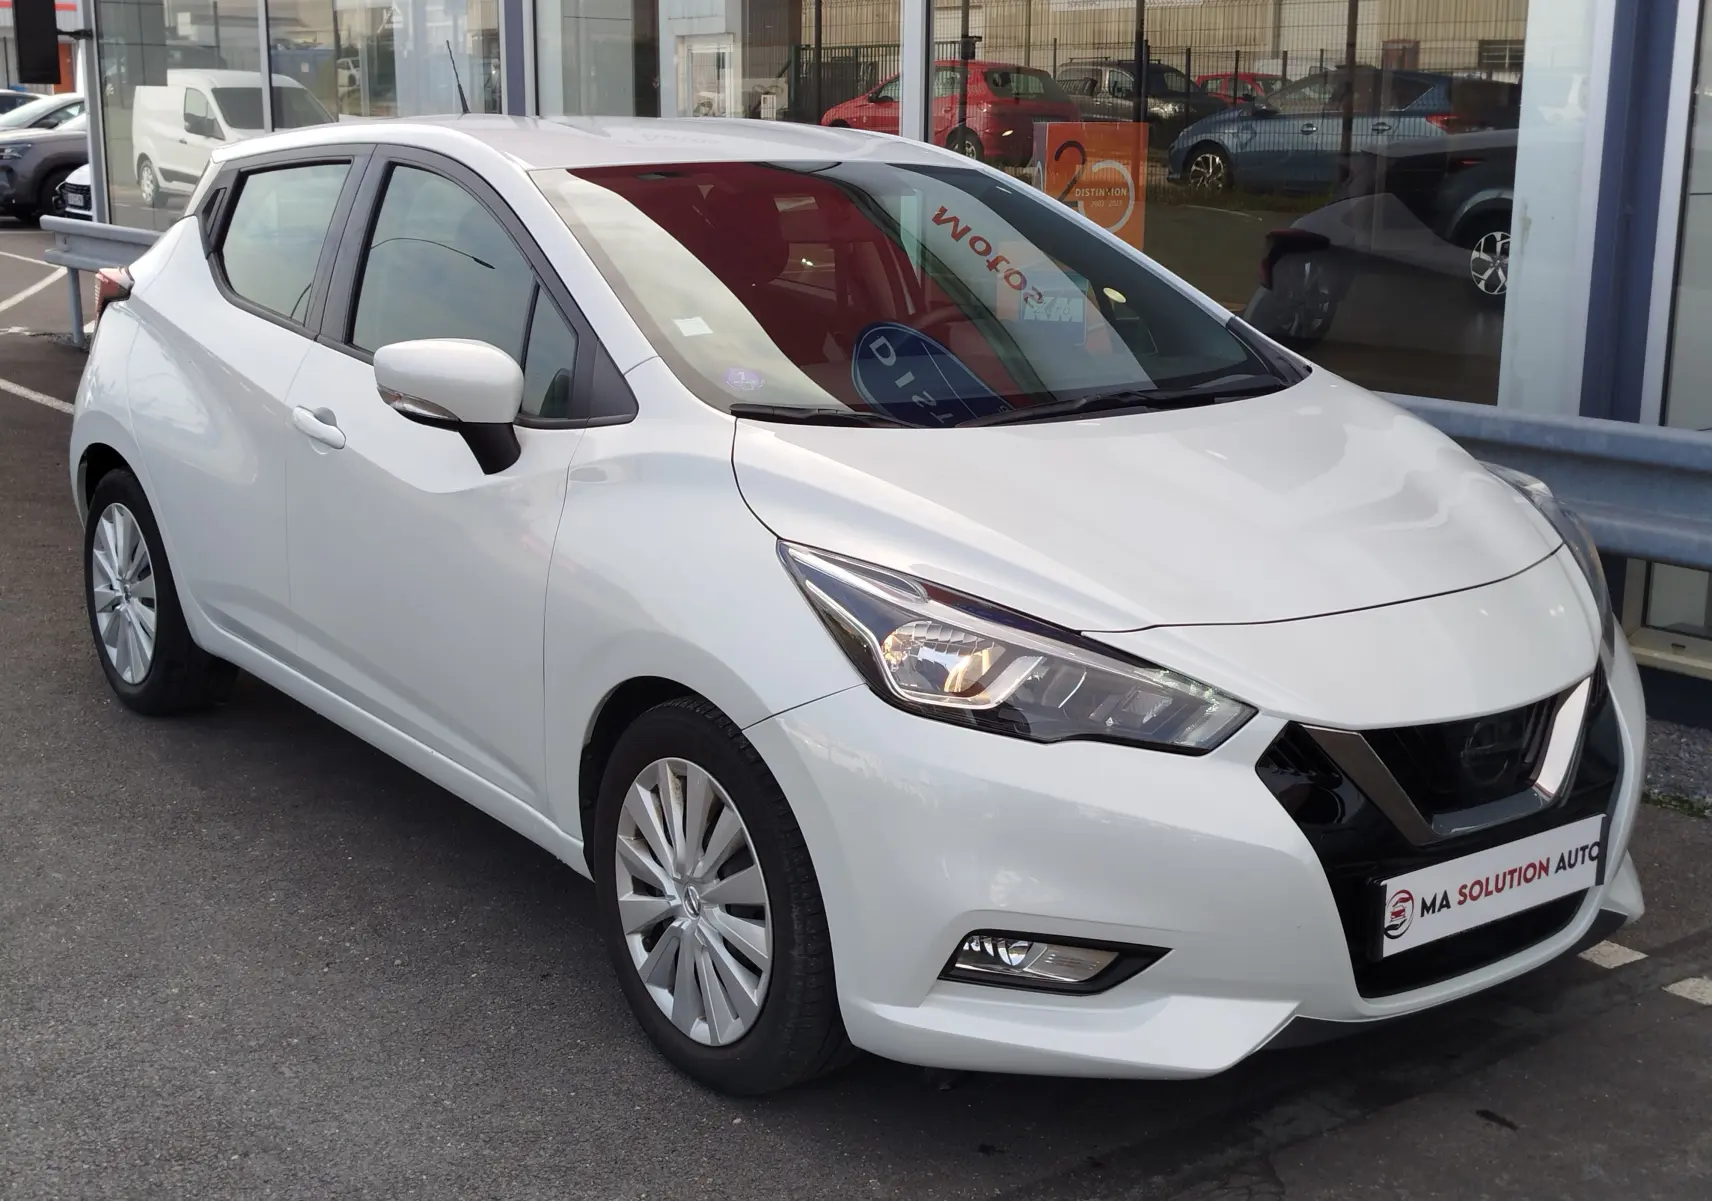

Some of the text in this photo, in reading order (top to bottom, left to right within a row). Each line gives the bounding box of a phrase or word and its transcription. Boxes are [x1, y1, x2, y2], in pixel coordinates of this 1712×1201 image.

[1420, 840, 1601, 918] MA SOLUTION AUTO
